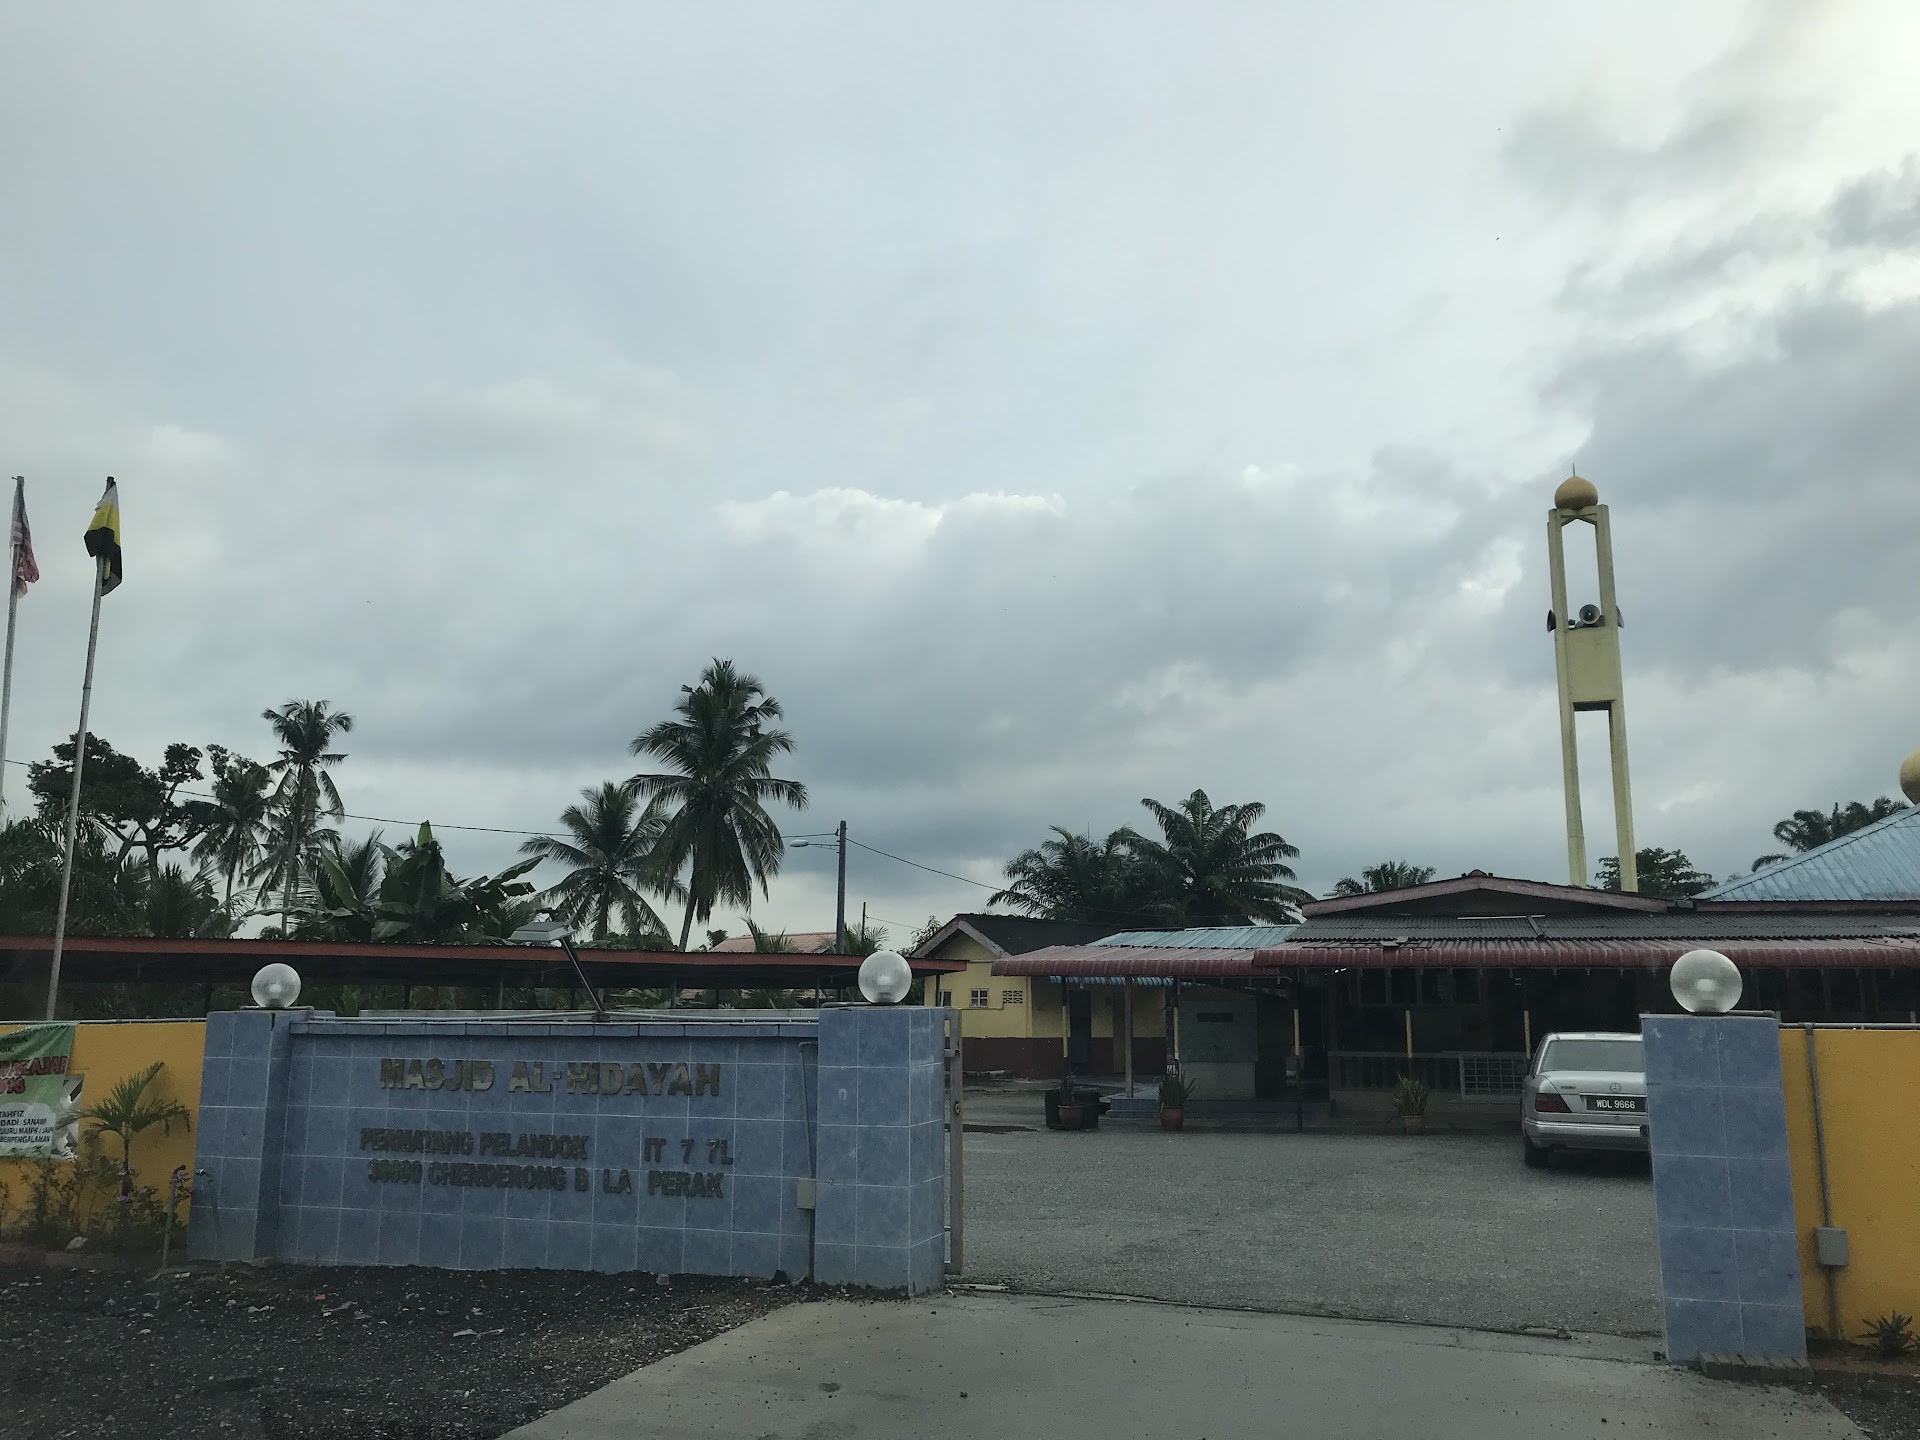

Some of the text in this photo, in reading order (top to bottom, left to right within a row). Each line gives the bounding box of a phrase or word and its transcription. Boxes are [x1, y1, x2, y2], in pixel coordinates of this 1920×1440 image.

[380, 1058, 721, 1097] MASJID AL-HIDAYAH
[1595, 1099, 1636, 1109] WDL 9666
[648, 1170, 724, 1199] PERAK
